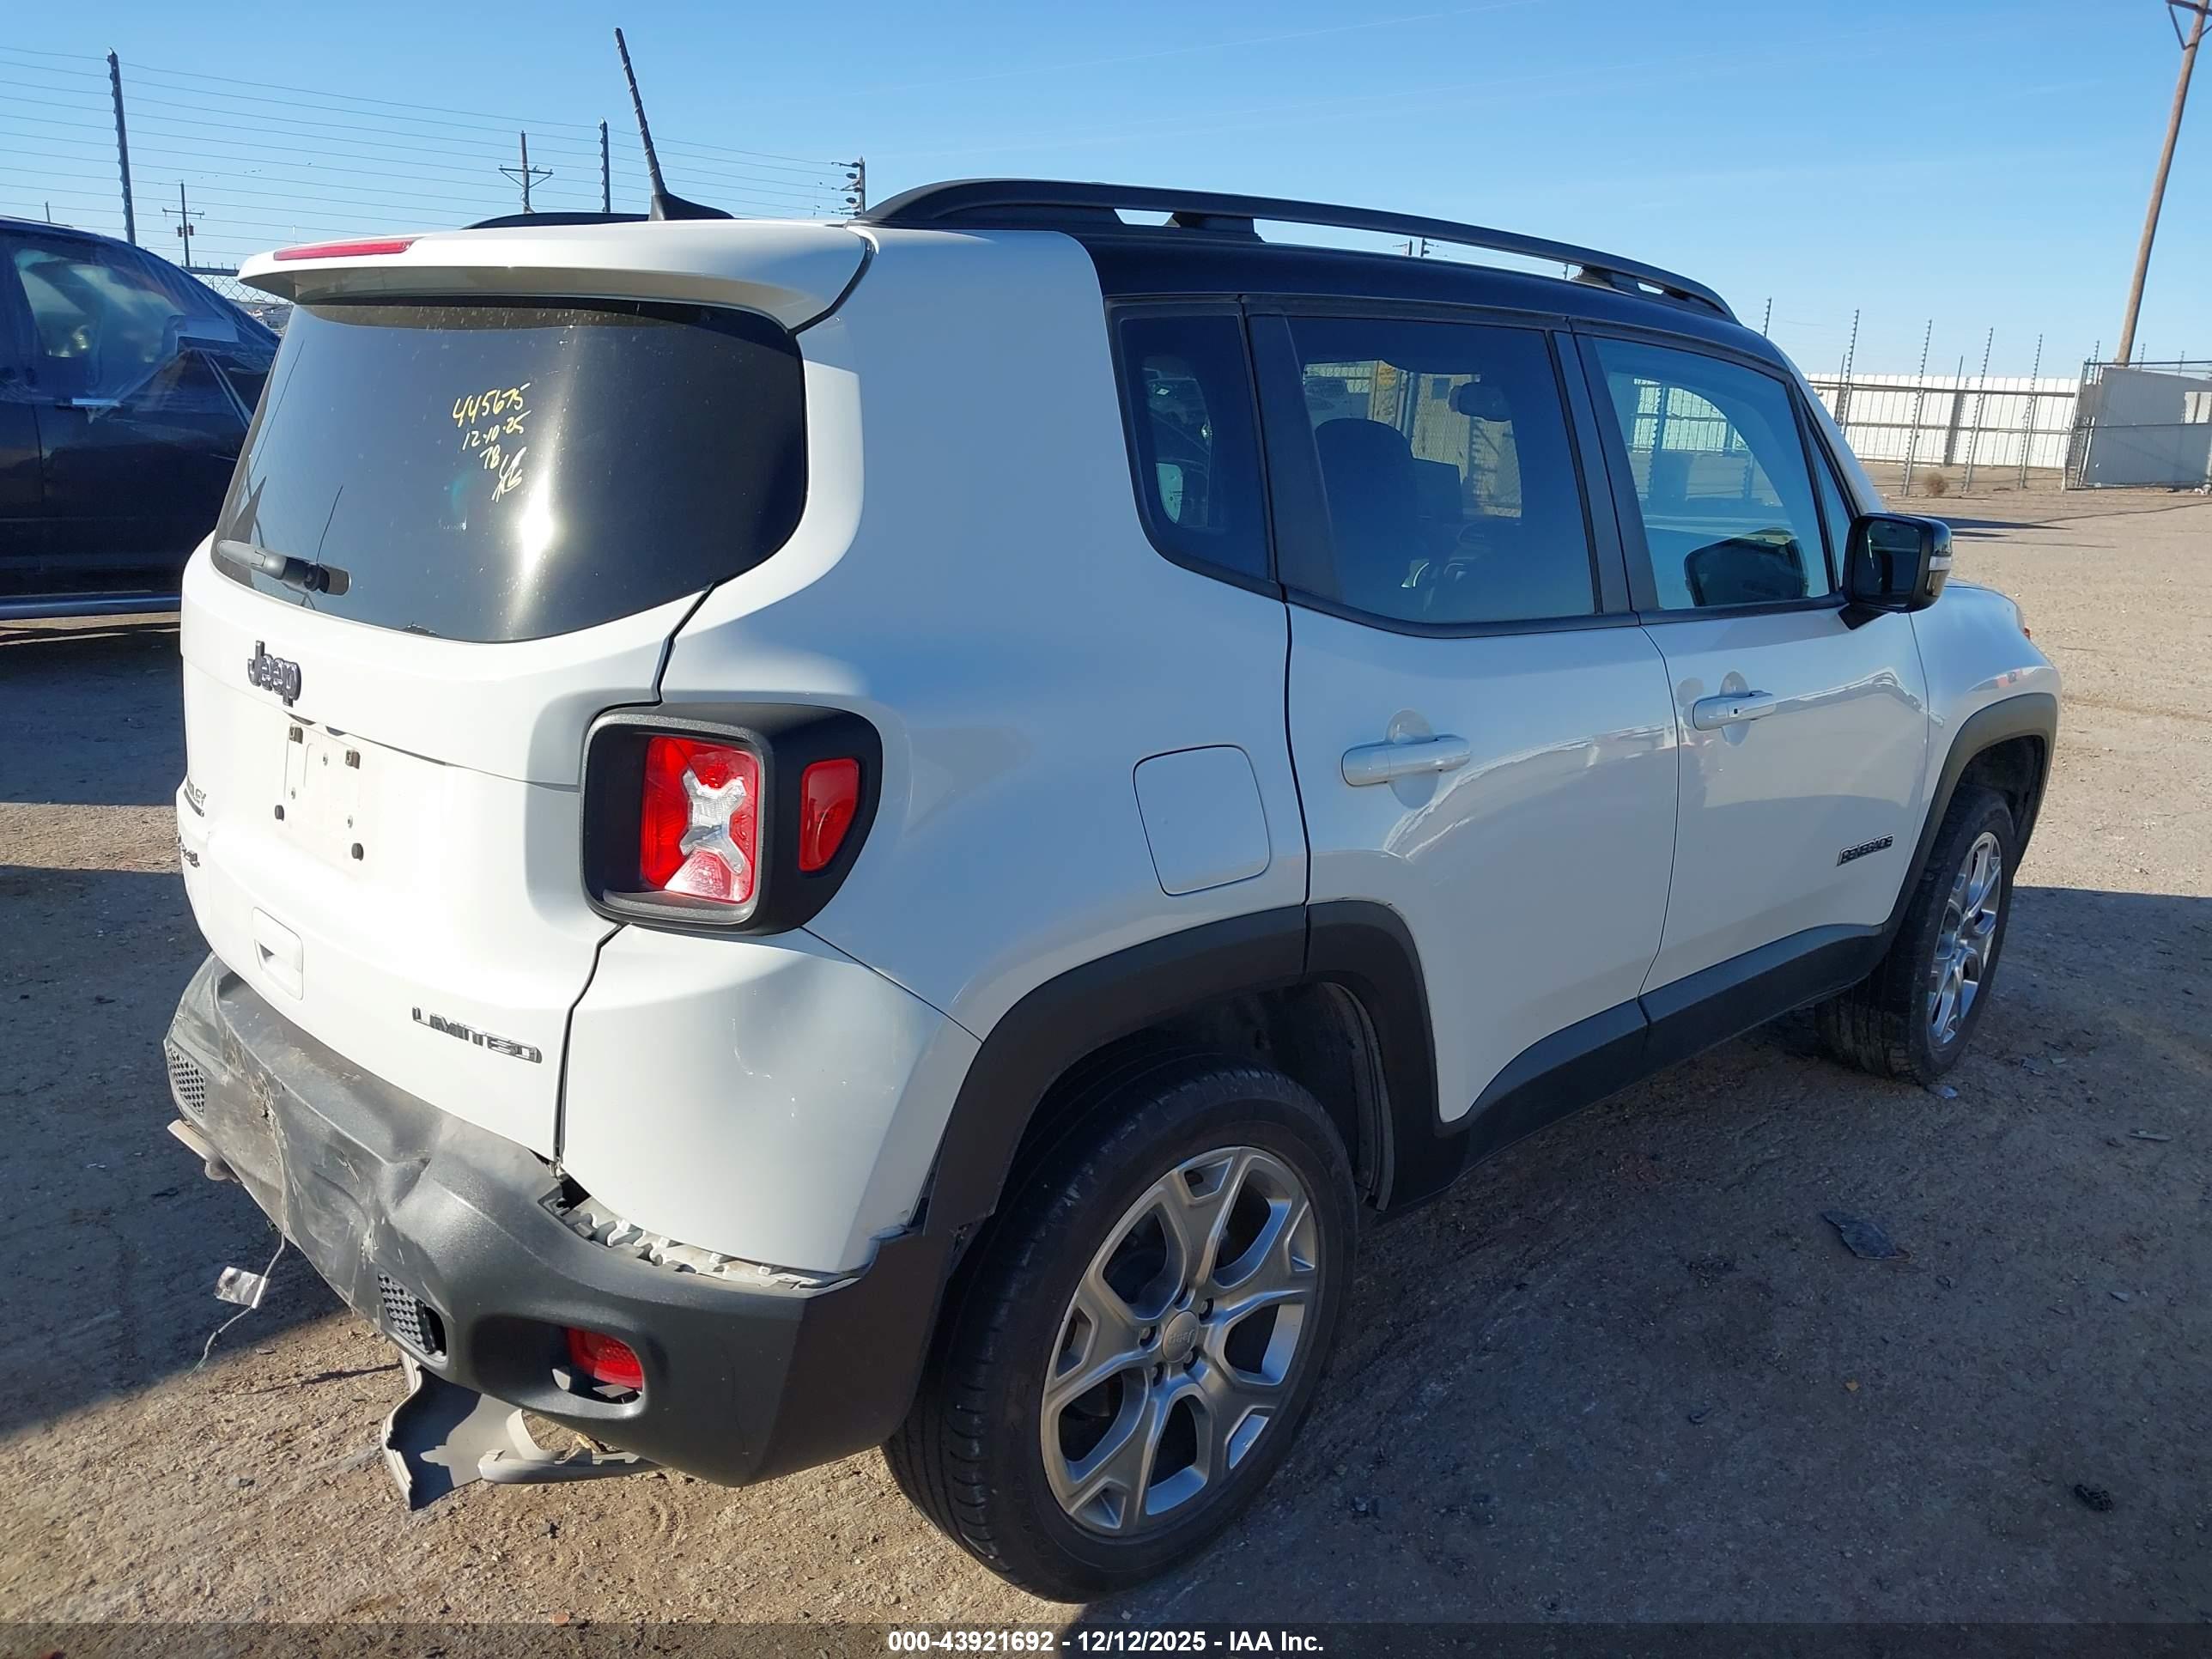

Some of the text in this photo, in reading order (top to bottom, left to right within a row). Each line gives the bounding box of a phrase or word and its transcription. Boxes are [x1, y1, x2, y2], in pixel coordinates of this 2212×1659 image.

[247, 640, 301, 708] Jeep
[1837, 833, 1894, 867] RENEGADE
[411, 1006, 543, 1065] LIMITED
